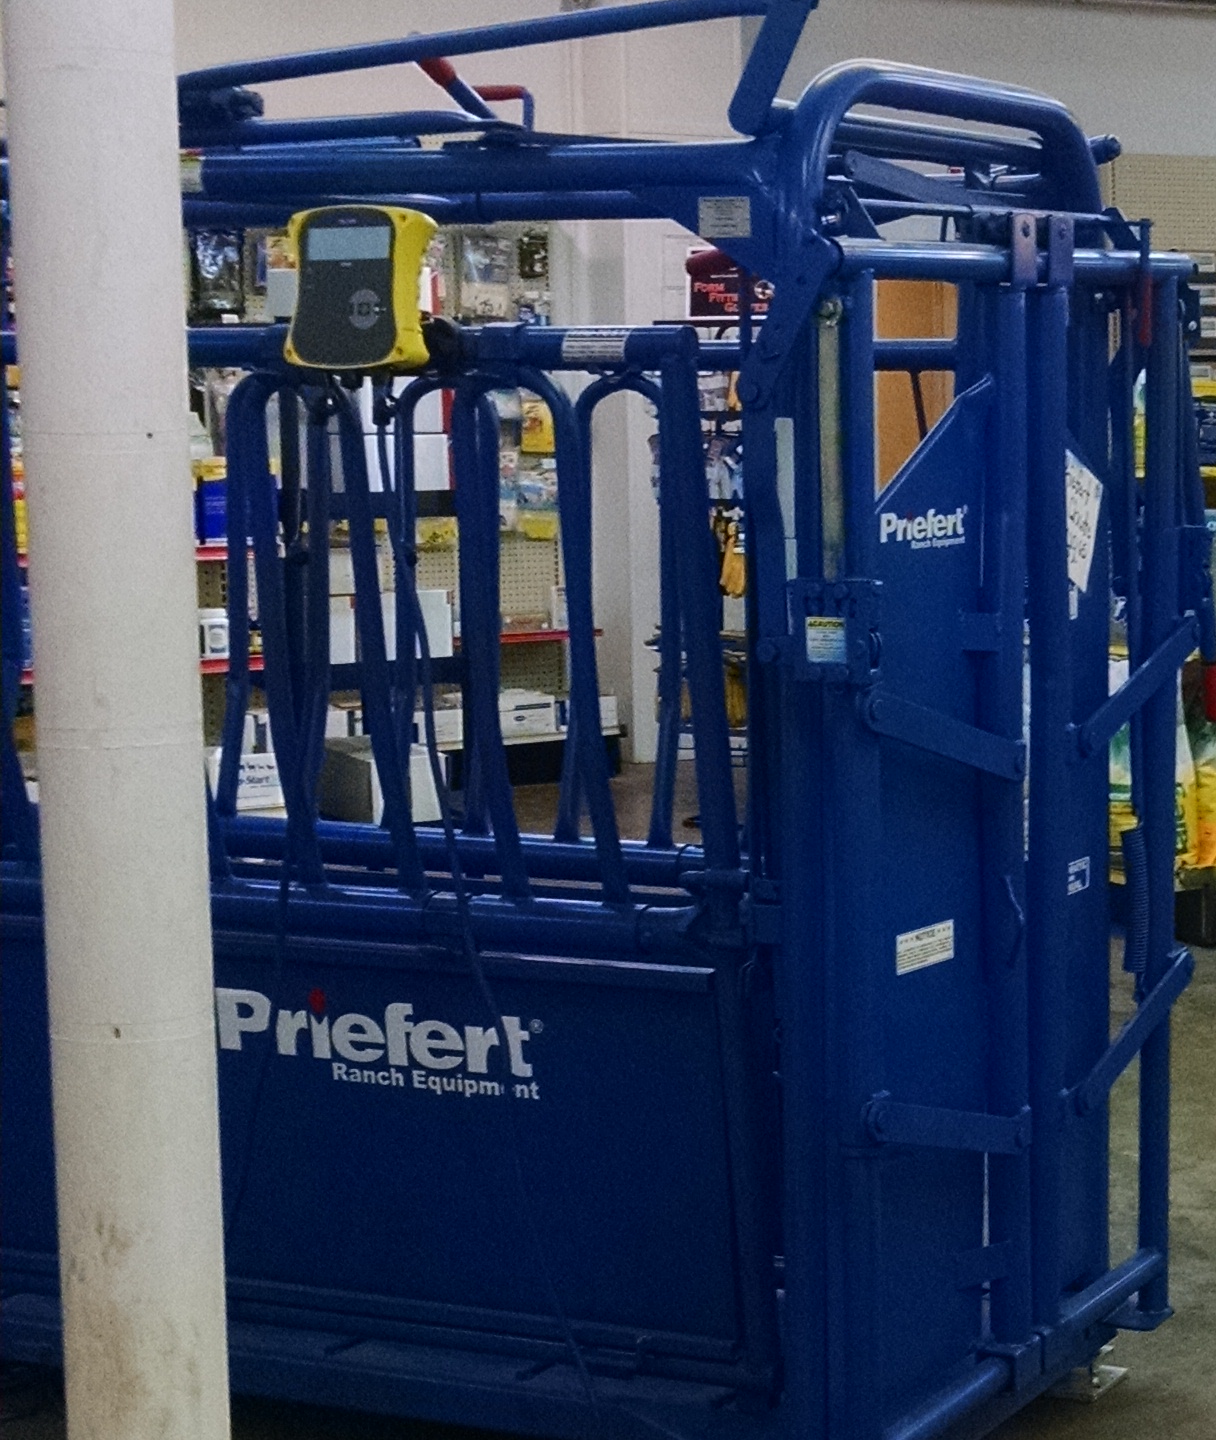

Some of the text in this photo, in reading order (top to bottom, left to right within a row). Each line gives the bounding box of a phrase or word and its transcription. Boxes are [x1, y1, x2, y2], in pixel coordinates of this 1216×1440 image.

[880, 508, 965, 544] Priefert
[215, 986, 533, 1078] Priefert
[332, 1061, 541, 1101] Ranch Equipmnt
